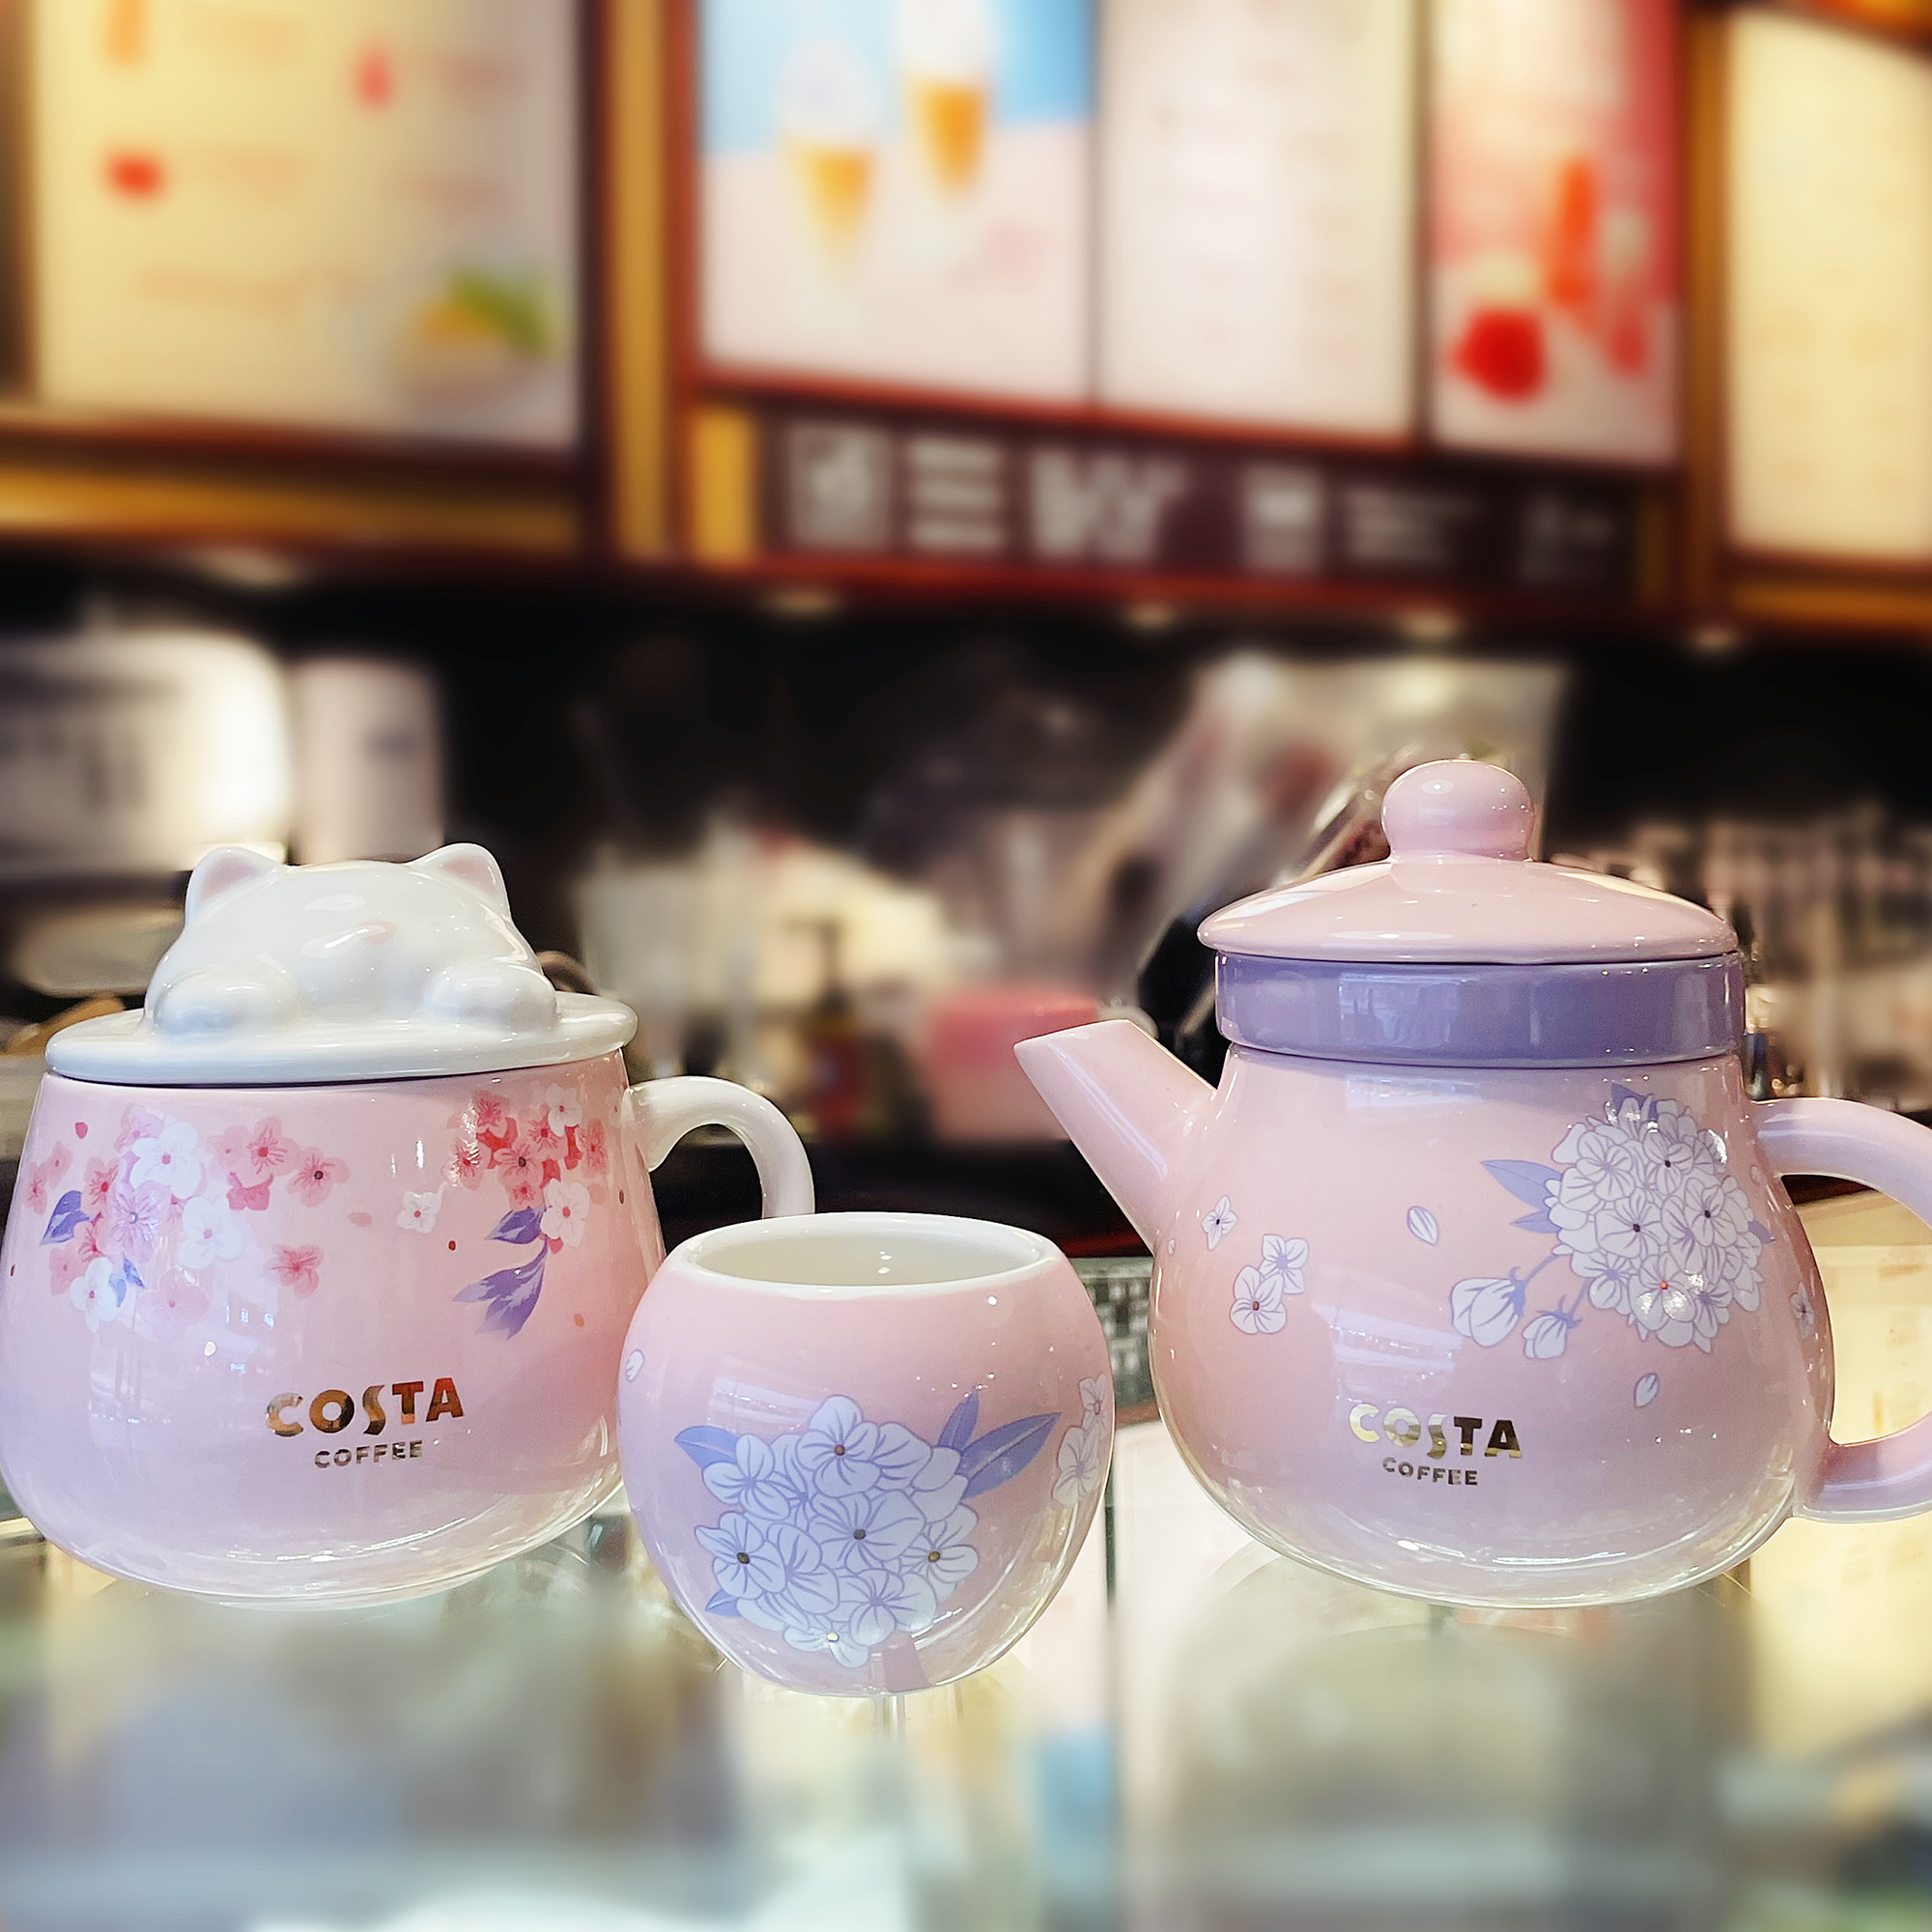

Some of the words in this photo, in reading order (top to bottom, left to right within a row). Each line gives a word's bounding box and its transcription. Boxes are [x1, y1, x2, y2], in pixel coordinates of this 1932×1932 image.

[266, 1377, 465, 1437] COSTA
[1349, 1403, 1522, 1460] COSTA
[314, 1439, 423, 1468] COFFEE
[1382, 1457, 1478, 1486] COFFEE
